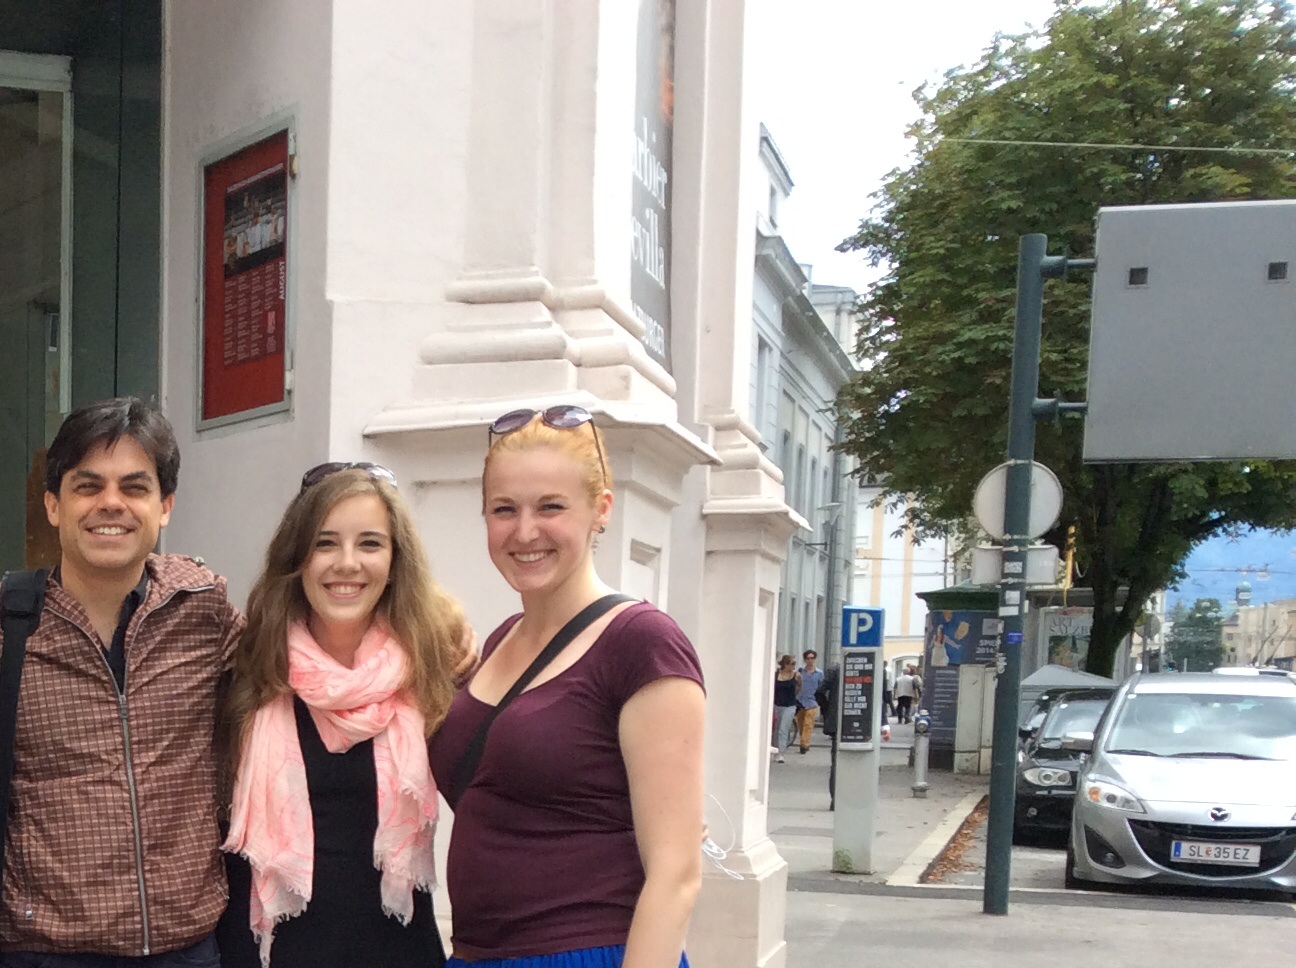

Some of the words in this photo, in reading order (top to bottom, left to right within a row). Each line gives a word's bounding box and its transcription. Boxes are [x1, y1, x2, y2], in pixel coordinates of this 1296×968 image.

[849, 612, 873, 645] P
[1189, 845, 1204, 857] SL
[1214, 847, 1230, 859] 35
[1233, 848, 1250, 860] EZ
